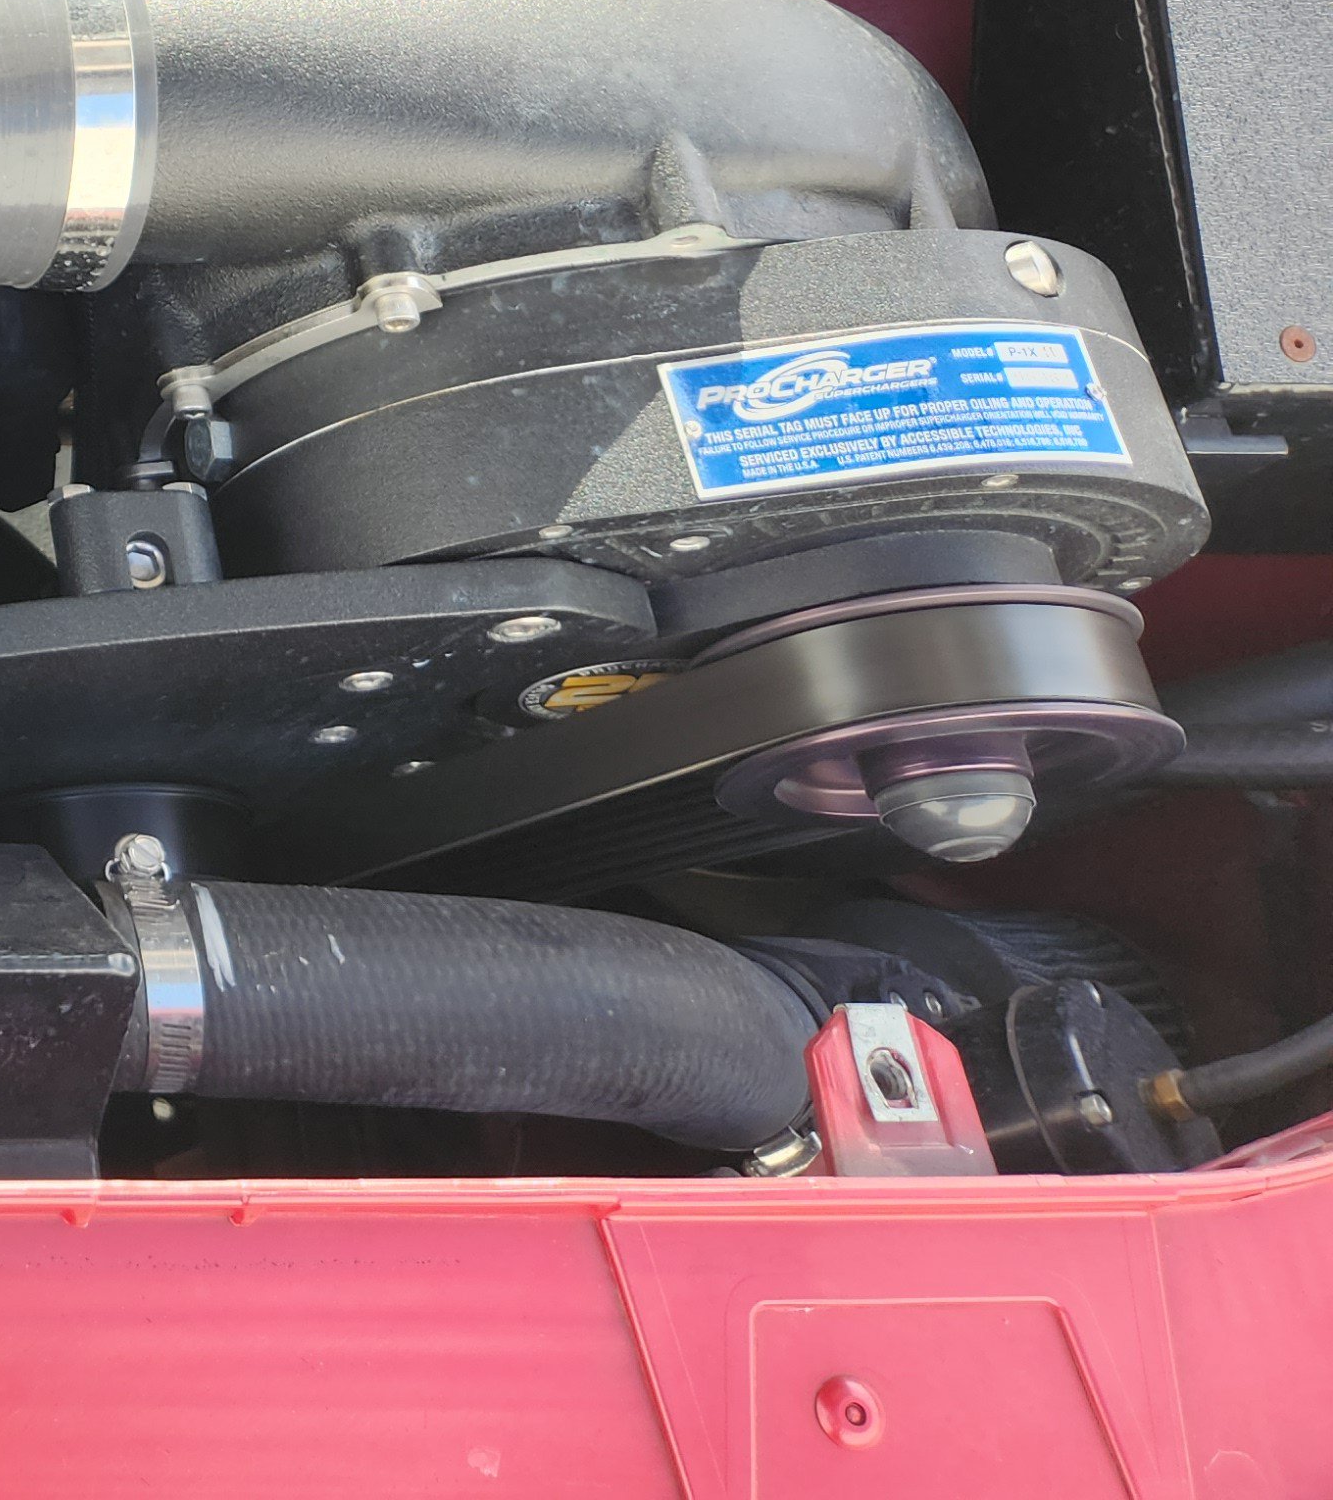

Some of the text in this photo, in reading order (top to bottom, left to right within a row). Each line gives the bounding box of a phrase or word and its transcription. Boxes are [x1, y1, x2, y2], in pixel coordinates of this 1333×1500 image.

[810, 377, 938, 401] SUPERCHARGERS
[959, 372, 1004, 385] SERIAL#
[706, 396, 1093, 445] THIS SERIAL TAG MUST FACE UP FOR PROPER OILING AND OPERATION
[697, 444, 731, 457] FAILURE
[732, 441, 744, 451] TO
[744, 437, 776, 450] FOLLOW
[777, 434, 810, 447] SERVICE
[811, 427, 861, 444] PROCEDURE
[862, 424, 875, 434] OR
[874, 418, 918, 432] IMPROPER
[918, 412, 983, 426] SUPERCHARGER
[739, 449, 799, 467] SERVICED
[801, 437, 879, 460] EXCLUSIVELY
[879, 435, 897, 448] BY
[900, 426, 975, 445] ACCESSIBLE
[855, 449, 887, 463] PATENT
[887, 444, 929, 459] NUMBERS
[742, 462, 795, 479] MADE IN THE
